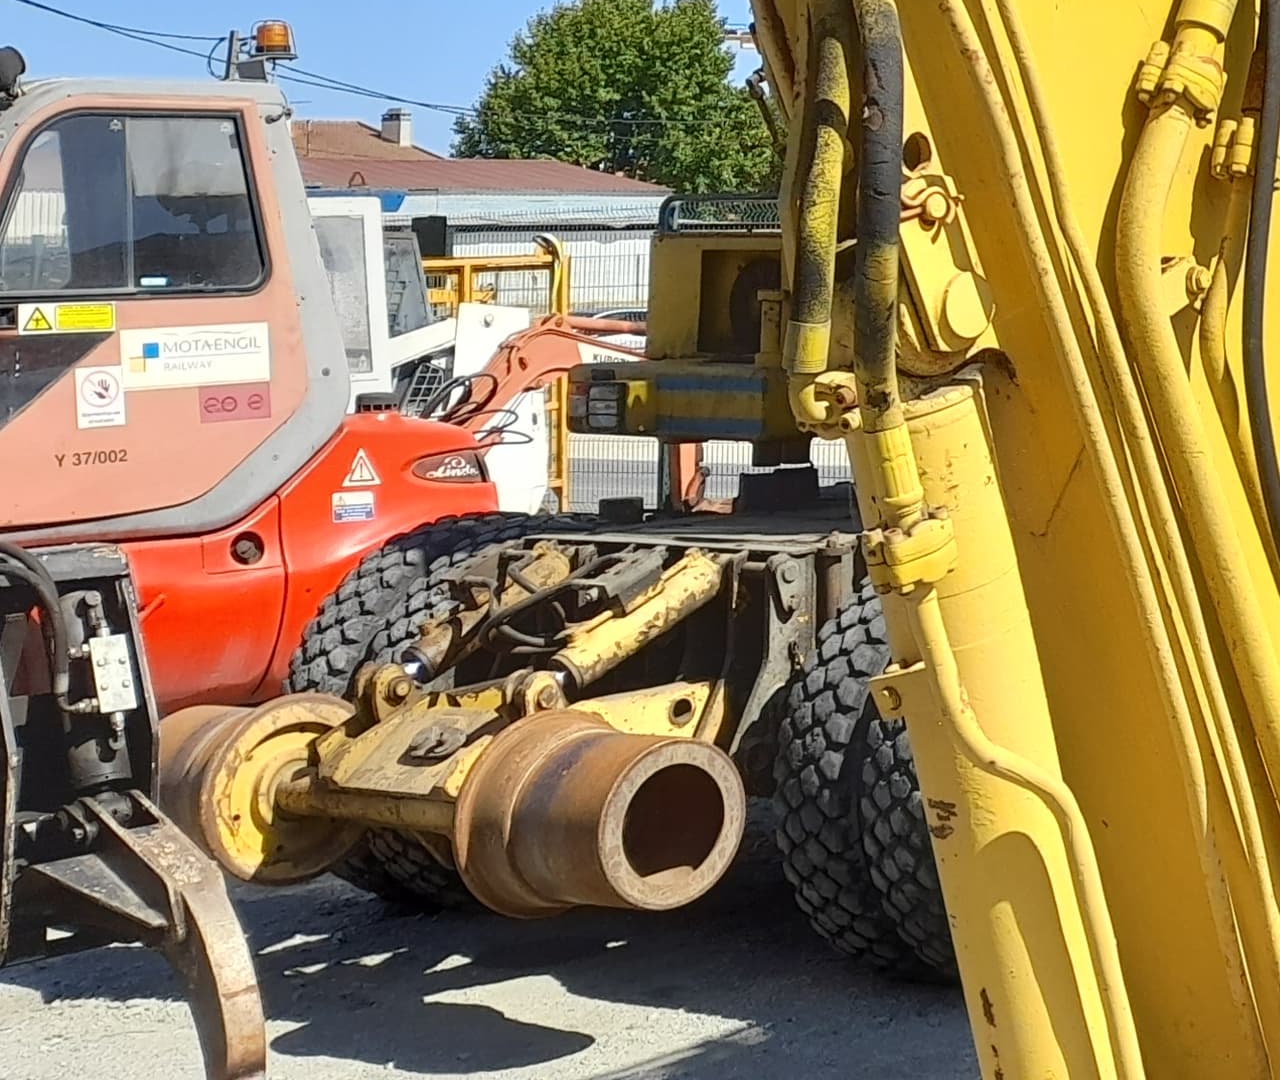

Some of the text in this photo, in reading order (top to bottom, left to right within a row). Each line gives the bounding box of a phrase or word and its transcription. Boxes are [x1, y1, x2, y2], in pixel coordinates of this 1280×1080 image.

[163, 360, 213, 372] RAILWAY
[55, 449, 128, 467] Y 37/002
